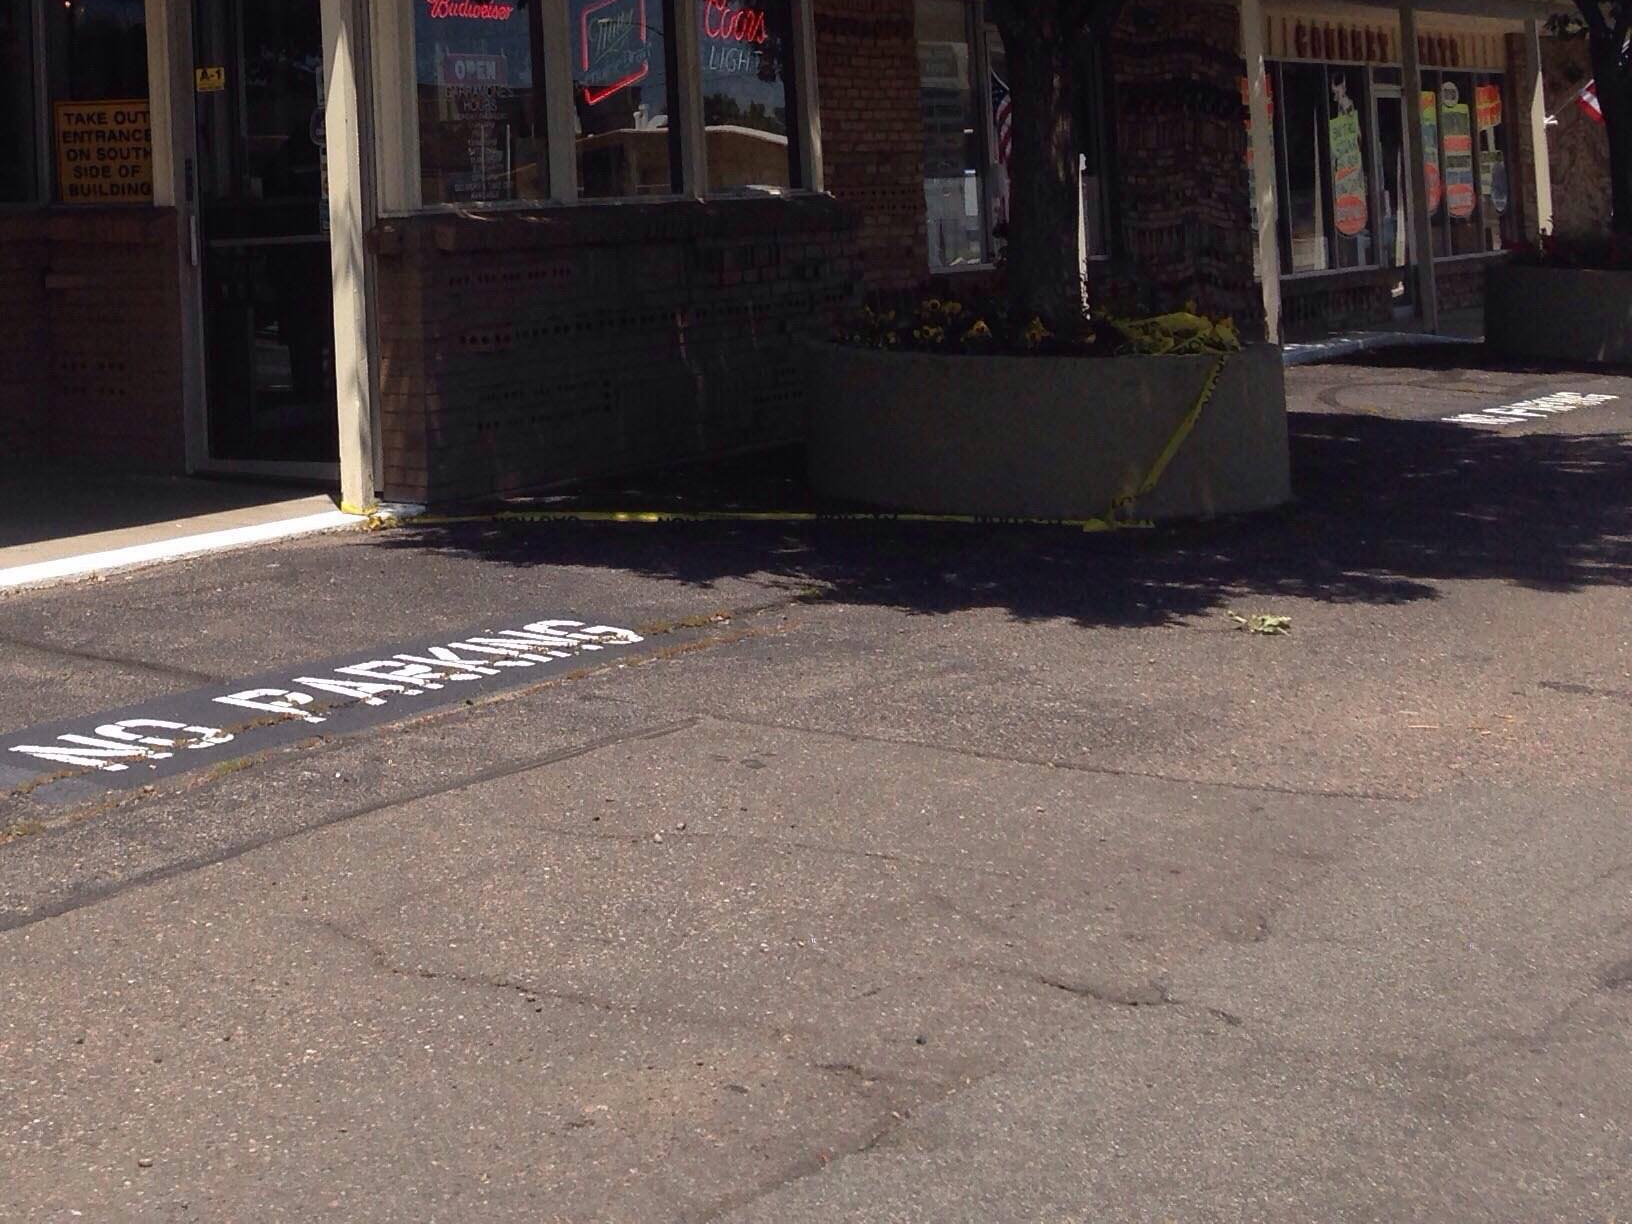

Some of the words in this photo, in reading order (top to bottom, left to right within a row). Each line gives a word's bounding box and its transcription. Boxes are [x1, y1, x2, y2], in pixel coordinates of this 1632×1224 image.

[710, 46, 764, 73] LIGHT
[454, 59, 498, 80] OPEN
[64, 112, 108, 126] TAKE
[113, 111, 150, 125] OUT
[63, 129, 152, 144] ENTRANCE
[67, 148, 90, 162] ON
[96, 147, 152, 161] SOUTH
[73, 165, 111, 179] SIDE
[118, 164, 141, 178] OF
[69, 183, 152, 197] BUILDING
[8, 718, 235, 772] NO
[212, 618, 645, 723] PARKING
